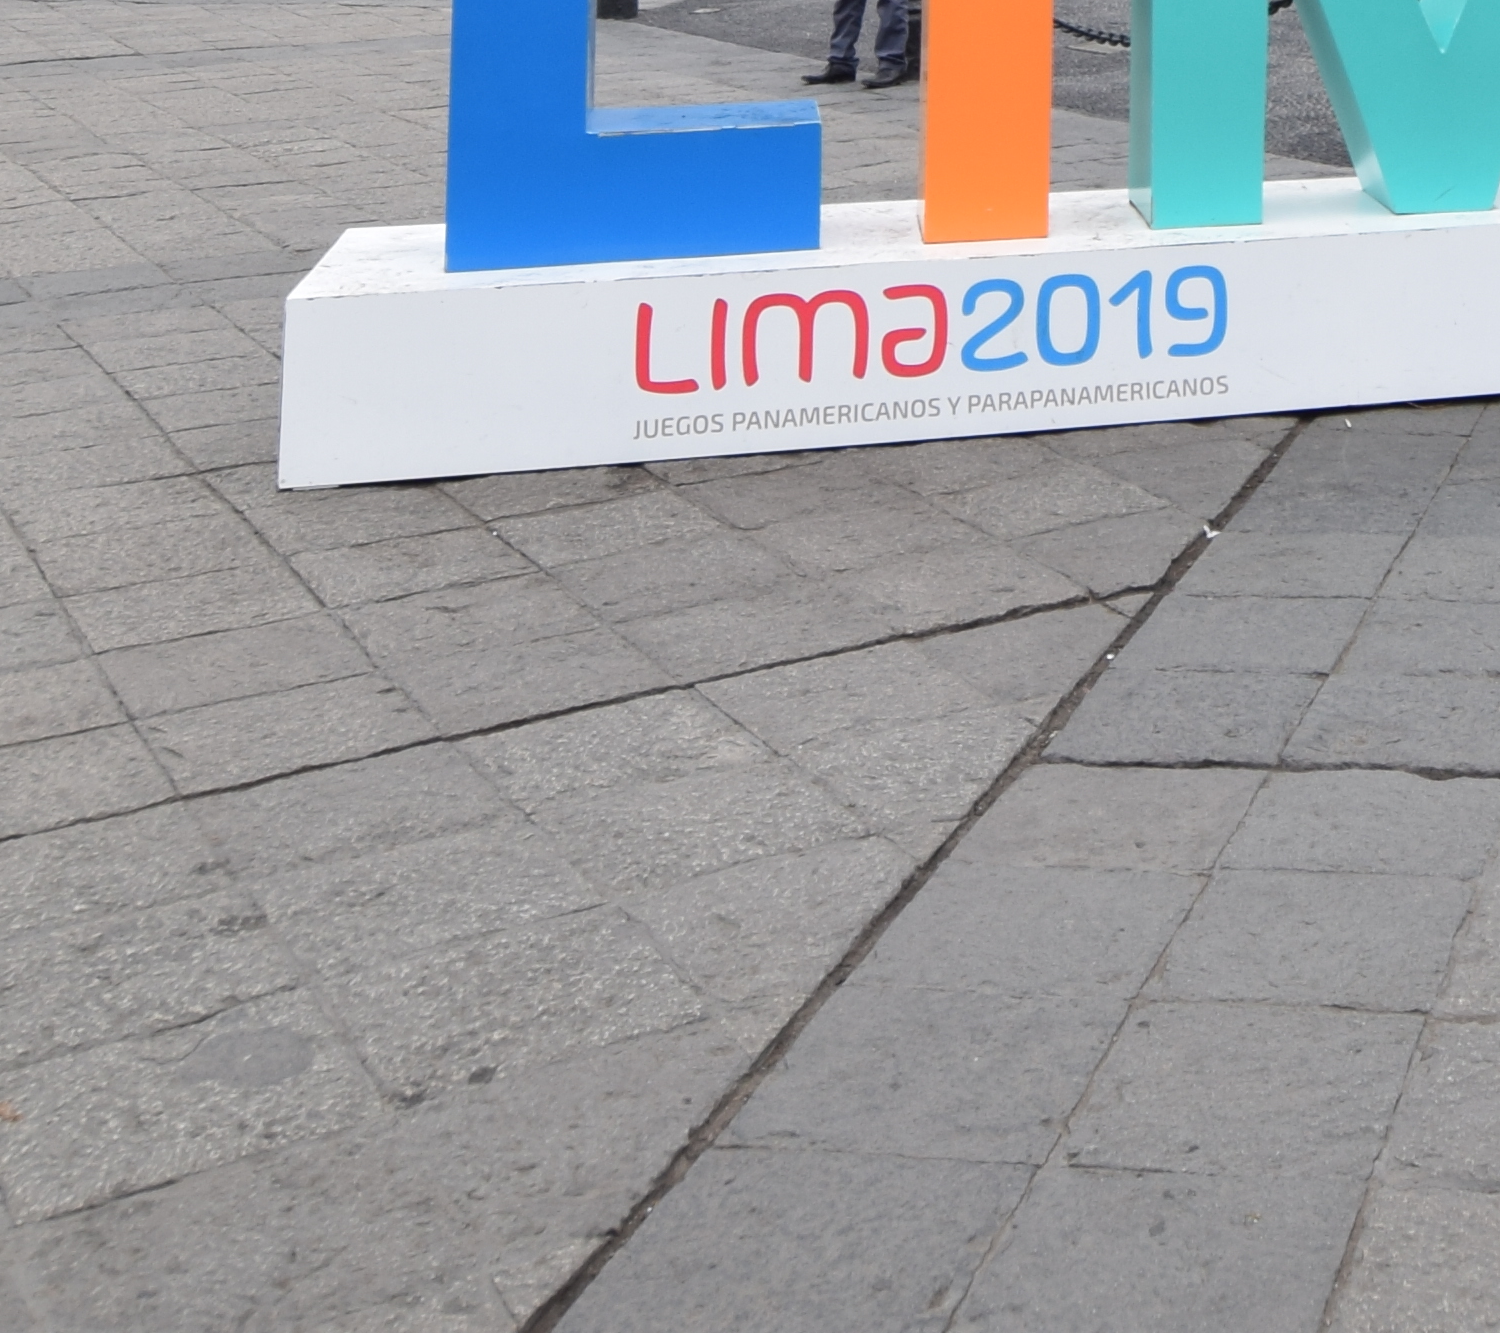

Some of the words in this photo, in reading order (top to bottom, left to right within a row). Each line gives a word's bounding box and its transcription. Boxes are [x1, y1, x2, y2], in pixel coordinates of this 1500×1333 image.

[633, 413, 725, 440] JUEGOS
[731, 397, 942, 432] PANAMERICANOS
[947, 396, 962, 416] Y
[967, 374, 1230, 415] PARAPANAMERICANOS
